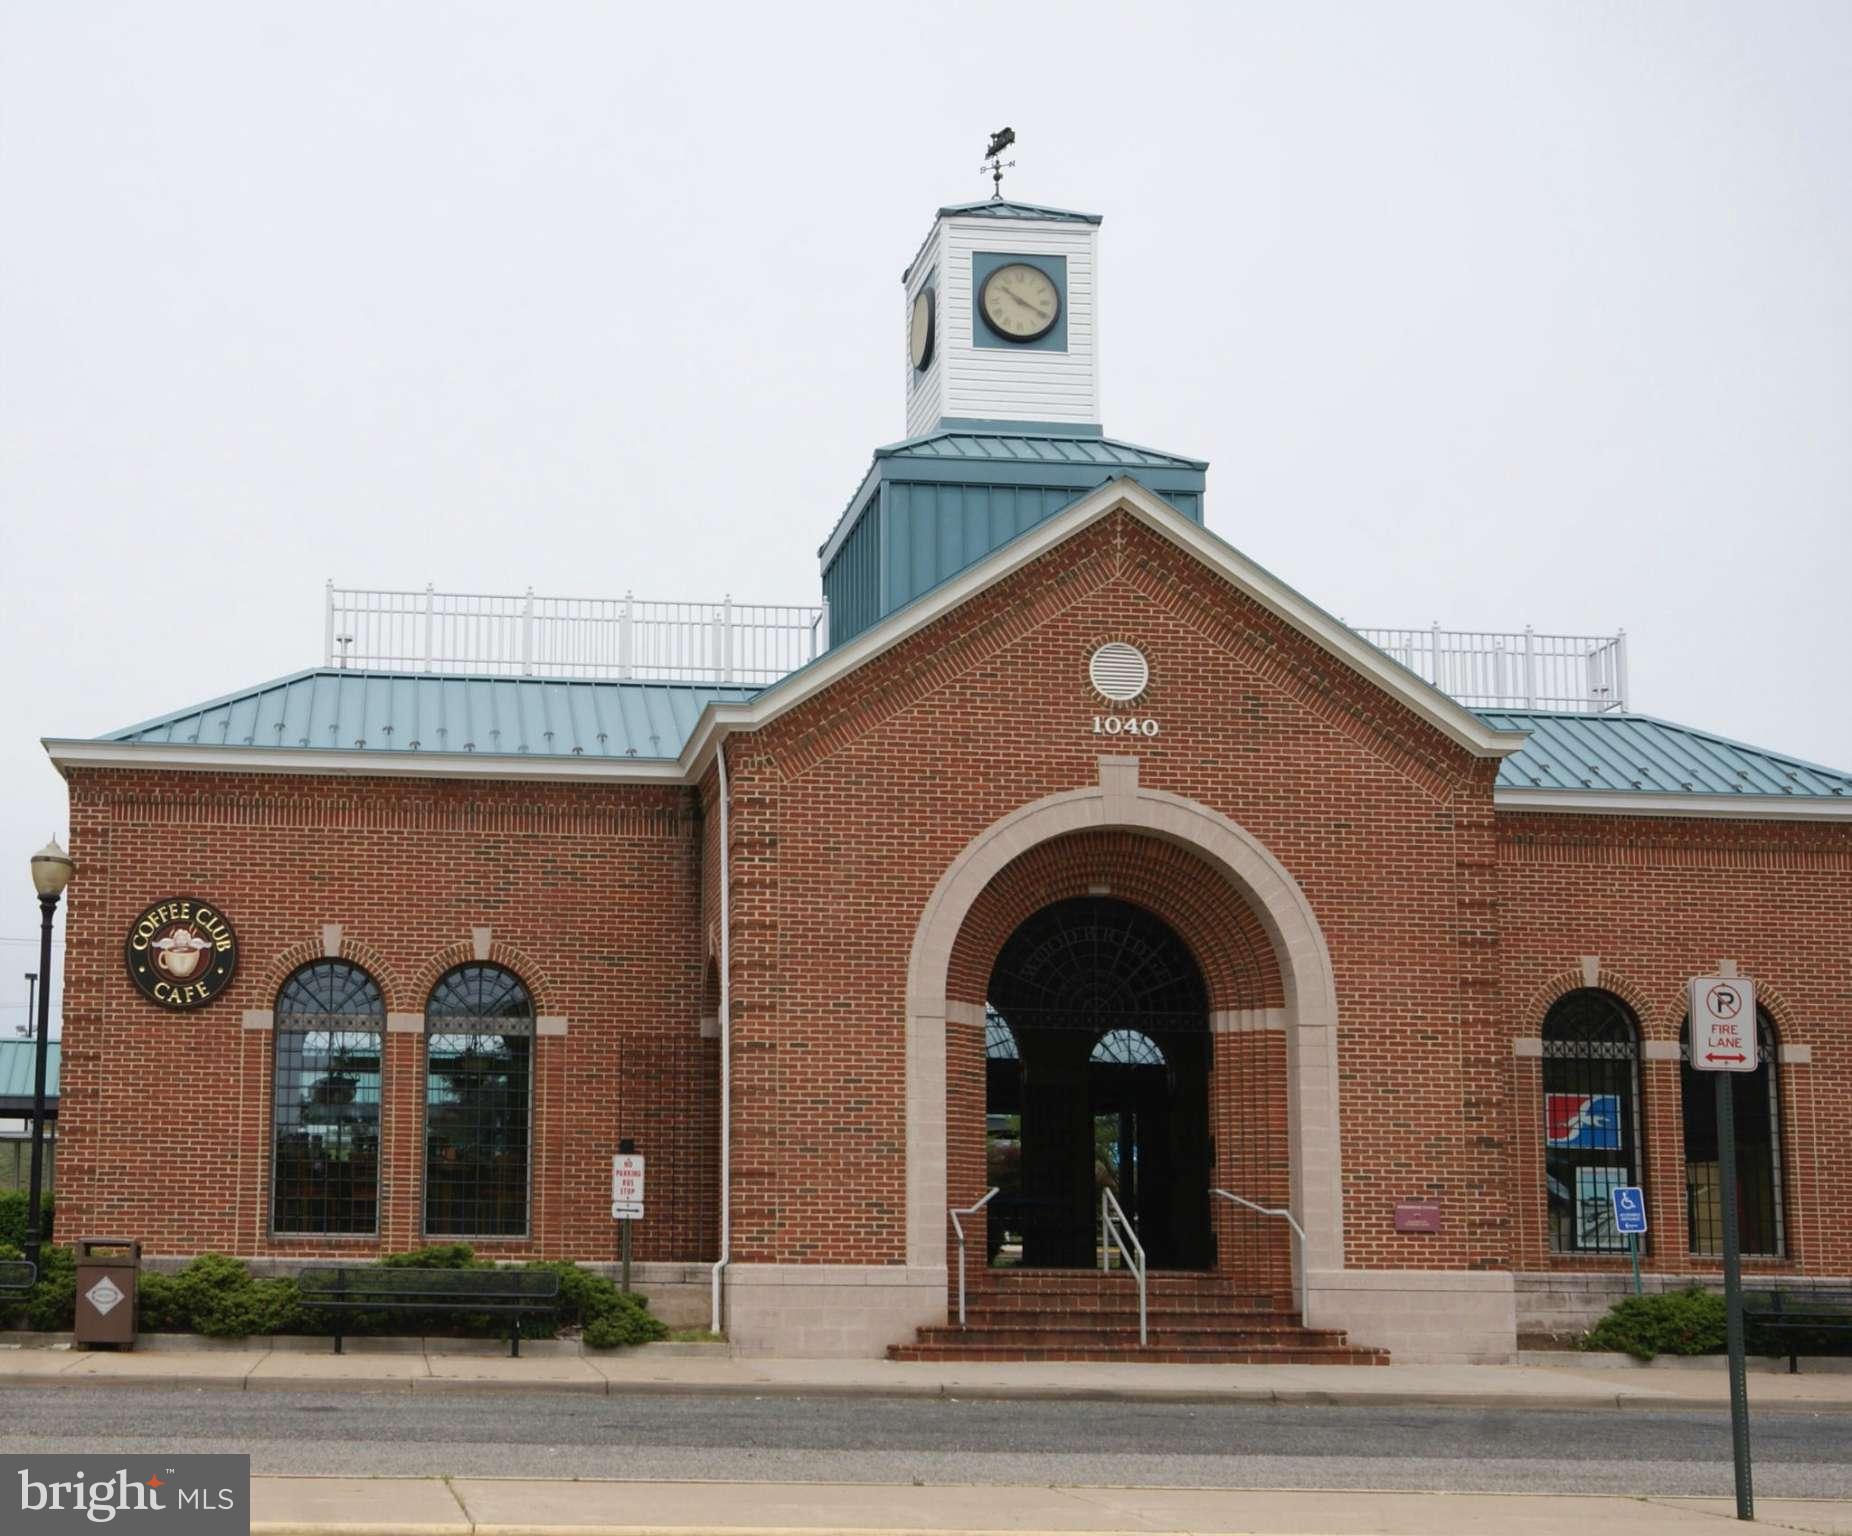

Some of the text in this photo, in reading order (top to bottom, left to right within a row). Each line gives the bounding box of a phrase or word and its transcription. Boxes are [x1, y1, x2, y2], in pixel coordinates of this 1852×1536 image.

[1092, 716, 1159, 736] 1040
[132, 903, 232, 952] COFFEE CLUB
[153, 981, 210, 1004] CAFE
[1711, 1024, 1739, 1035] FIRE
[1708, 1036, 1742, 1049] LANE
[615, 1169, 641, 1177] PARKING
